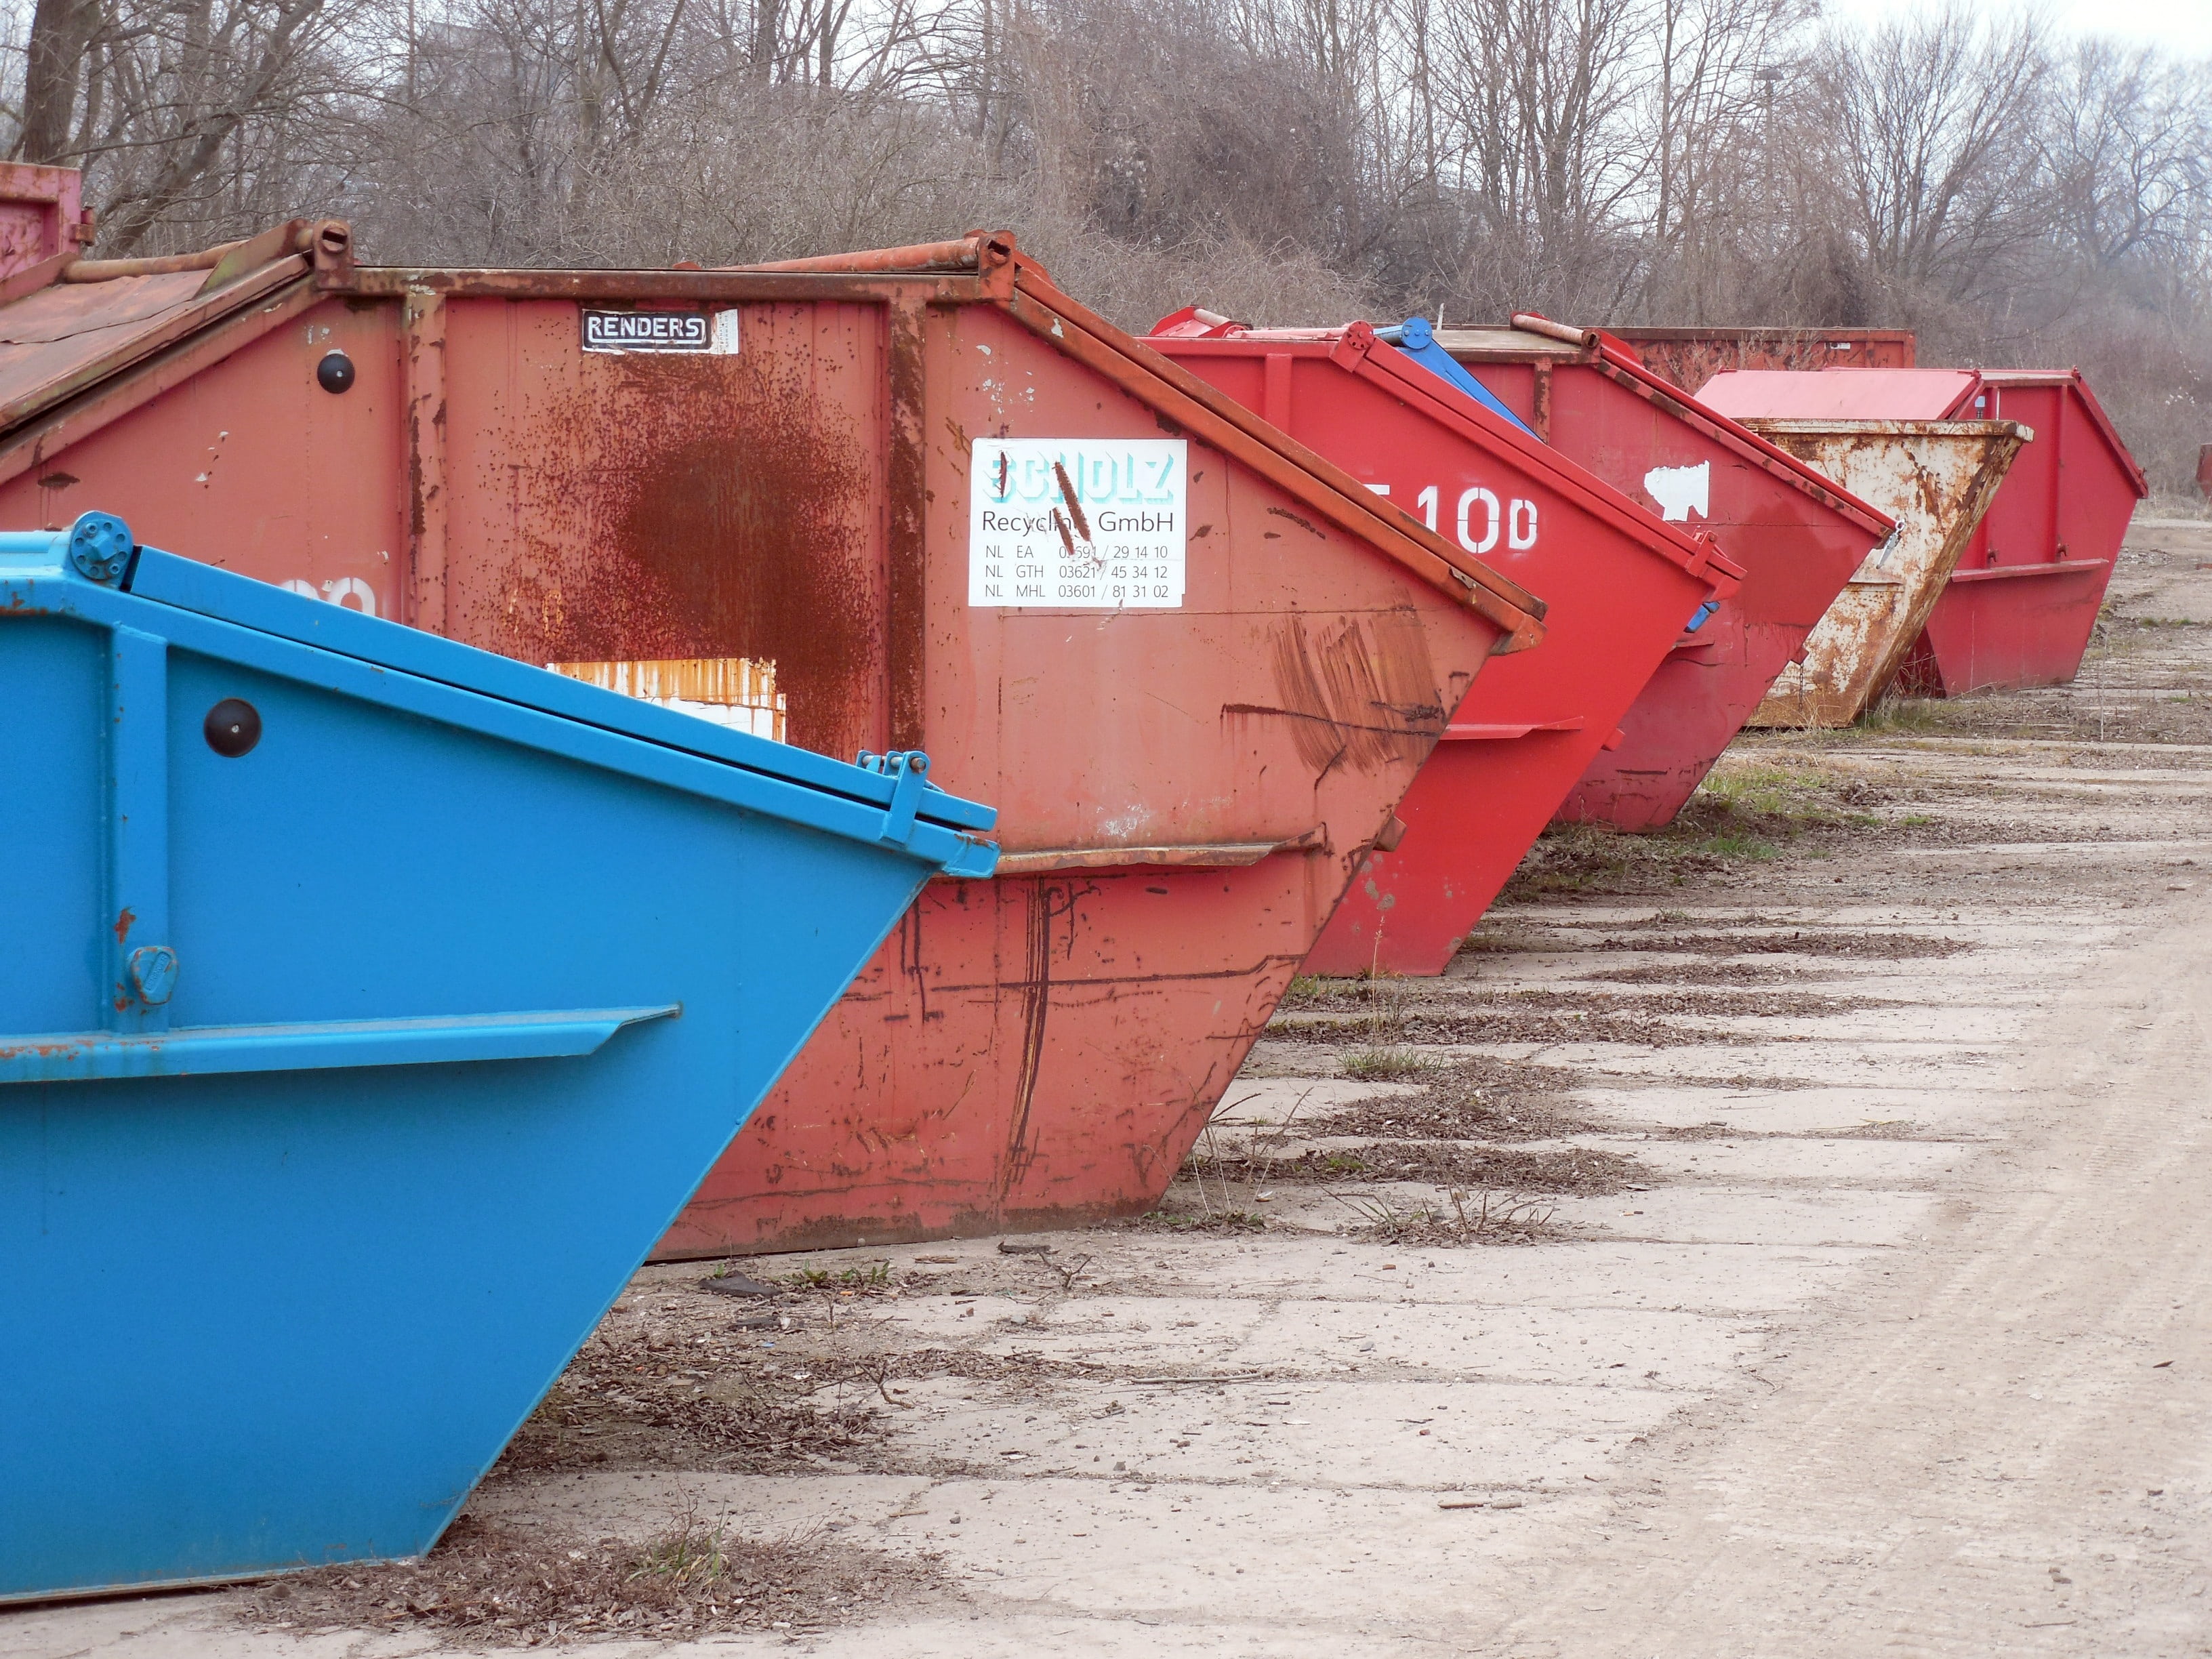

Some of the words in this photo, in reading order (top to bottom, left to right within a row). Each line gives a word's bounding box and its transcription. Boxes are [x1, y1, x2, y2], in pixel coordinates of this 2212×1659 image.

[588, 316, 700, 337] RENDERS
[982, 449, 1174, 504] SCHOLZ
[1099, 511, 1174, 532] GmbH
[986, 545, 1003, 558] NL
[1017, 545, 1033, 558] EA
[1113, 546, 1130, 558] 29
[1135, 546, 1148, 558] 14
[1155, 546, 1168, 558] 10
[986, 565, 1003, 578] NL
[1017, 565, 1044, 578] GTH
[1059, 565, 1095, 578] 03621
[1111, 566, 1126, 578] 45
[1132, 566, 1148, 578] 34
[1155, 566, 1168, 578] 12
[985, 584, 1003, 597] NL
[1017, 584, 1046, 597] MHL
[1059, 584, 1095, 597] 03601
[1113, 585, 1126, 598] 81
[1133, 585, 1146, 598] 31
[1154, 585, 1168, 598] 02
